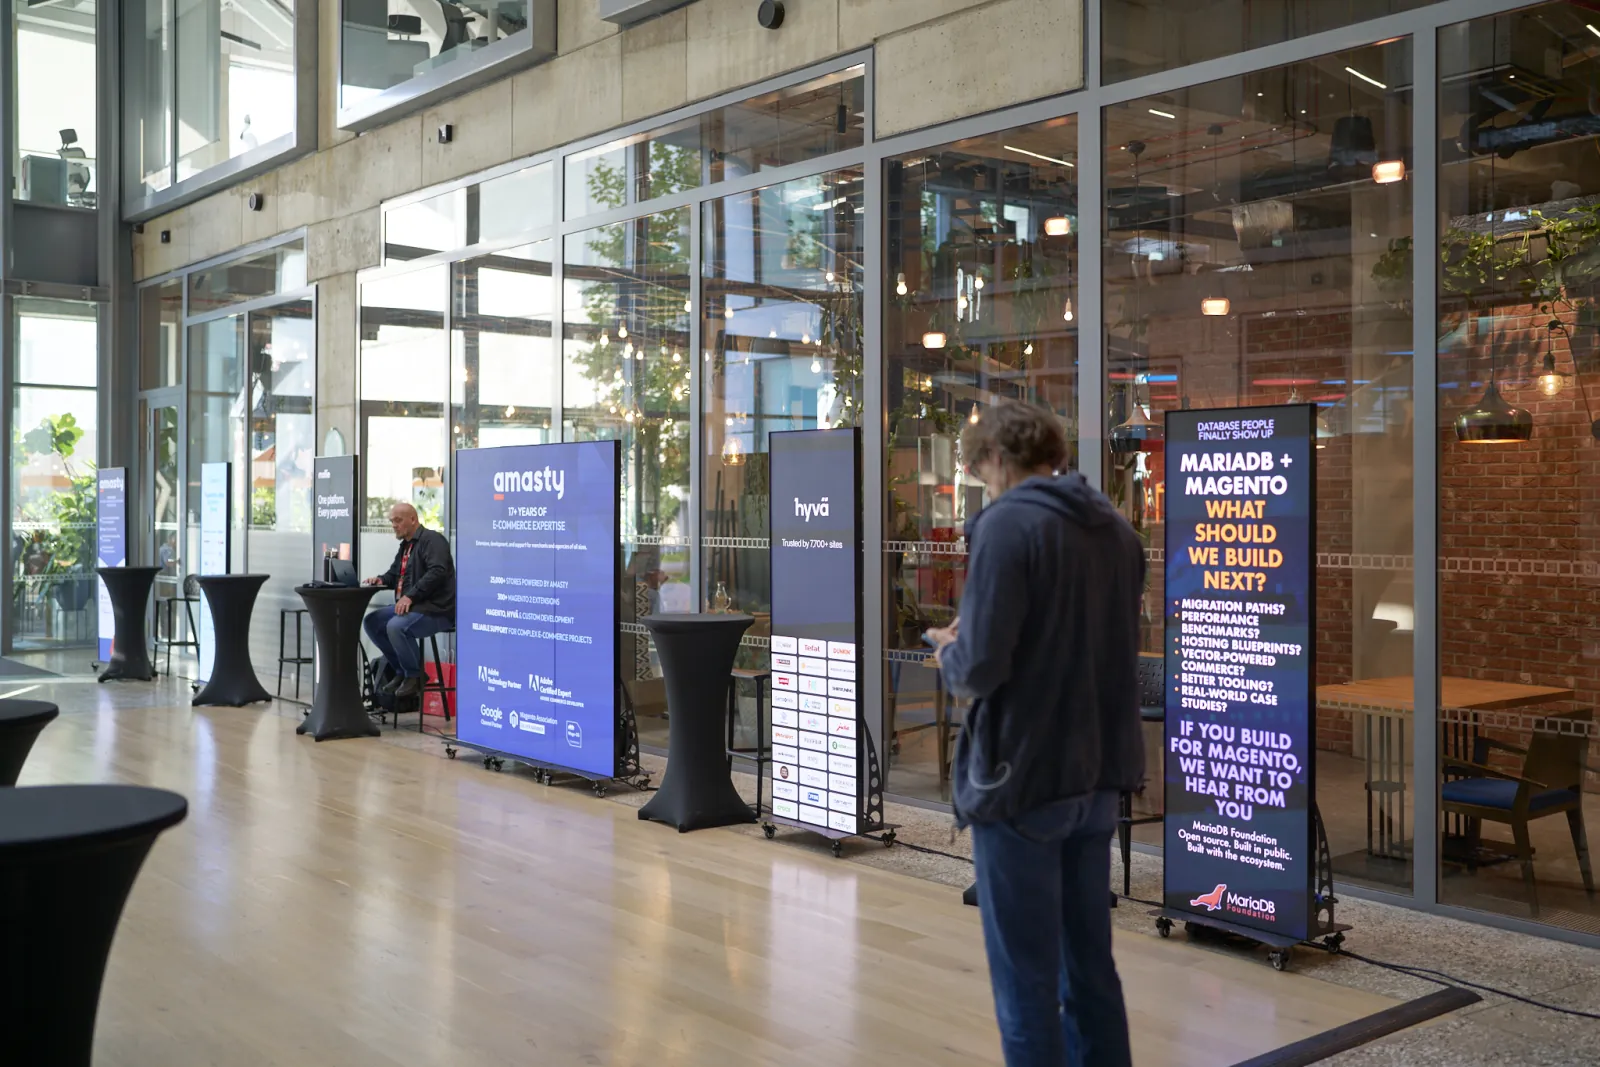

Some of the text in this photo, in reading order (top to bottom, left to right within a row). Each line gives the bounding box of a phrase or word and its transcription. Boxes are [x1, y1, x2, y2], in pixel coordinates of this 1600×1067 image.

[1197, 419, 1275, 432] DATABASE PEOPLE
[1198, 429, 1274, 441] FINALLY SHOW UP
[1180, 451, 1293, 472] MARIADB +
[99, 477, 124, 491] amasty
[493, 465, 565, 500] amasty
[1184, 475, 1288, 496] MAGENTO
[318, 494, 327, 505] One
[318, 507, 330, 519] Every
[508, 507, 547, 517] 17+ YEARS OF
[794, 496, 829, 523] hyvä
[1205, 500, 1266, 519] WHAT
[492, 519, 566, 531] E-COMMERCE EXPERTISE
[1195, 523, 1277, 544] SHOULD
[782, 538, 802, 548] Trusted
[802, 540, 810, 550] by
[829, 540, 843, 549] sites
[1188, 546, 1283, 568] WE BUILD
[506, 577, 521, 586] STORES
[522, 578, 543, 587] POWERED
[543, 580, 549, 588] BY
[550, 580, 569, 589] AMASTY
[1203, 571, 1266, 592] NEXT?
[508, 594, 529, 603] MAGENTO
[532, 596, 560, 606] EXTENSIONS
[1181, 598, 1286, 616] MIGRATION PATHS?
[523, 612, 540, 621] CUSTOM
[541, 614, 575, 625] DEVELOPMENT
[1181, 611, 1260, 627] PERFORMANCE
[508, 627, 518, 635] FOR
[518, 628, 538, 638] COMPLEX
[538, 630, 569, 642] E-COMMERCE
[569, 634, 593, 645] PROJECTS
[1181, 623, 1260, 639] BENCHMARKS?
[1181, 635, 1302, 656] HOSTING BLUEPRINTS?
[1181, 648, 1276, 667] VECTOR-POWERED
[488, 668, 499, 676] Adobe
[1181, 660, 1246, 676] COMMERCE?
[508, 680, 522, 690] Partner
[540, 676, 553, 686] Adobe
[1181, 673, 1274, 692] BETTER TOOLING?
[540, 686, 572, 699] Certified Expert
[1181, 685, 1278, 706] REAL-WORLD CASE
[480, 704, 503, 722] Google
[1181, 697, 1228, 712] STUDIES?
[1180, 720, 1292, 750] IF YOU BUILD
[1171, 737, 1302, 774] FOR MAGENTO,
[1179, 756, 1292, 789] WE WANT TO
[1185, 776, 1286, 808] HEAR FROM
[1215, 799, 1253, 821] YOU
[1192, 820, 1278, 846] MariaDB Foundation
[1178, 829, 1292, 861] Open source. Built in public.
[1187, 841, 1285, 871] Built with the ecosystem.
[1226, 891, 1276, 914] MariaDB
[1226, 903, 1276, 922] Foundation
